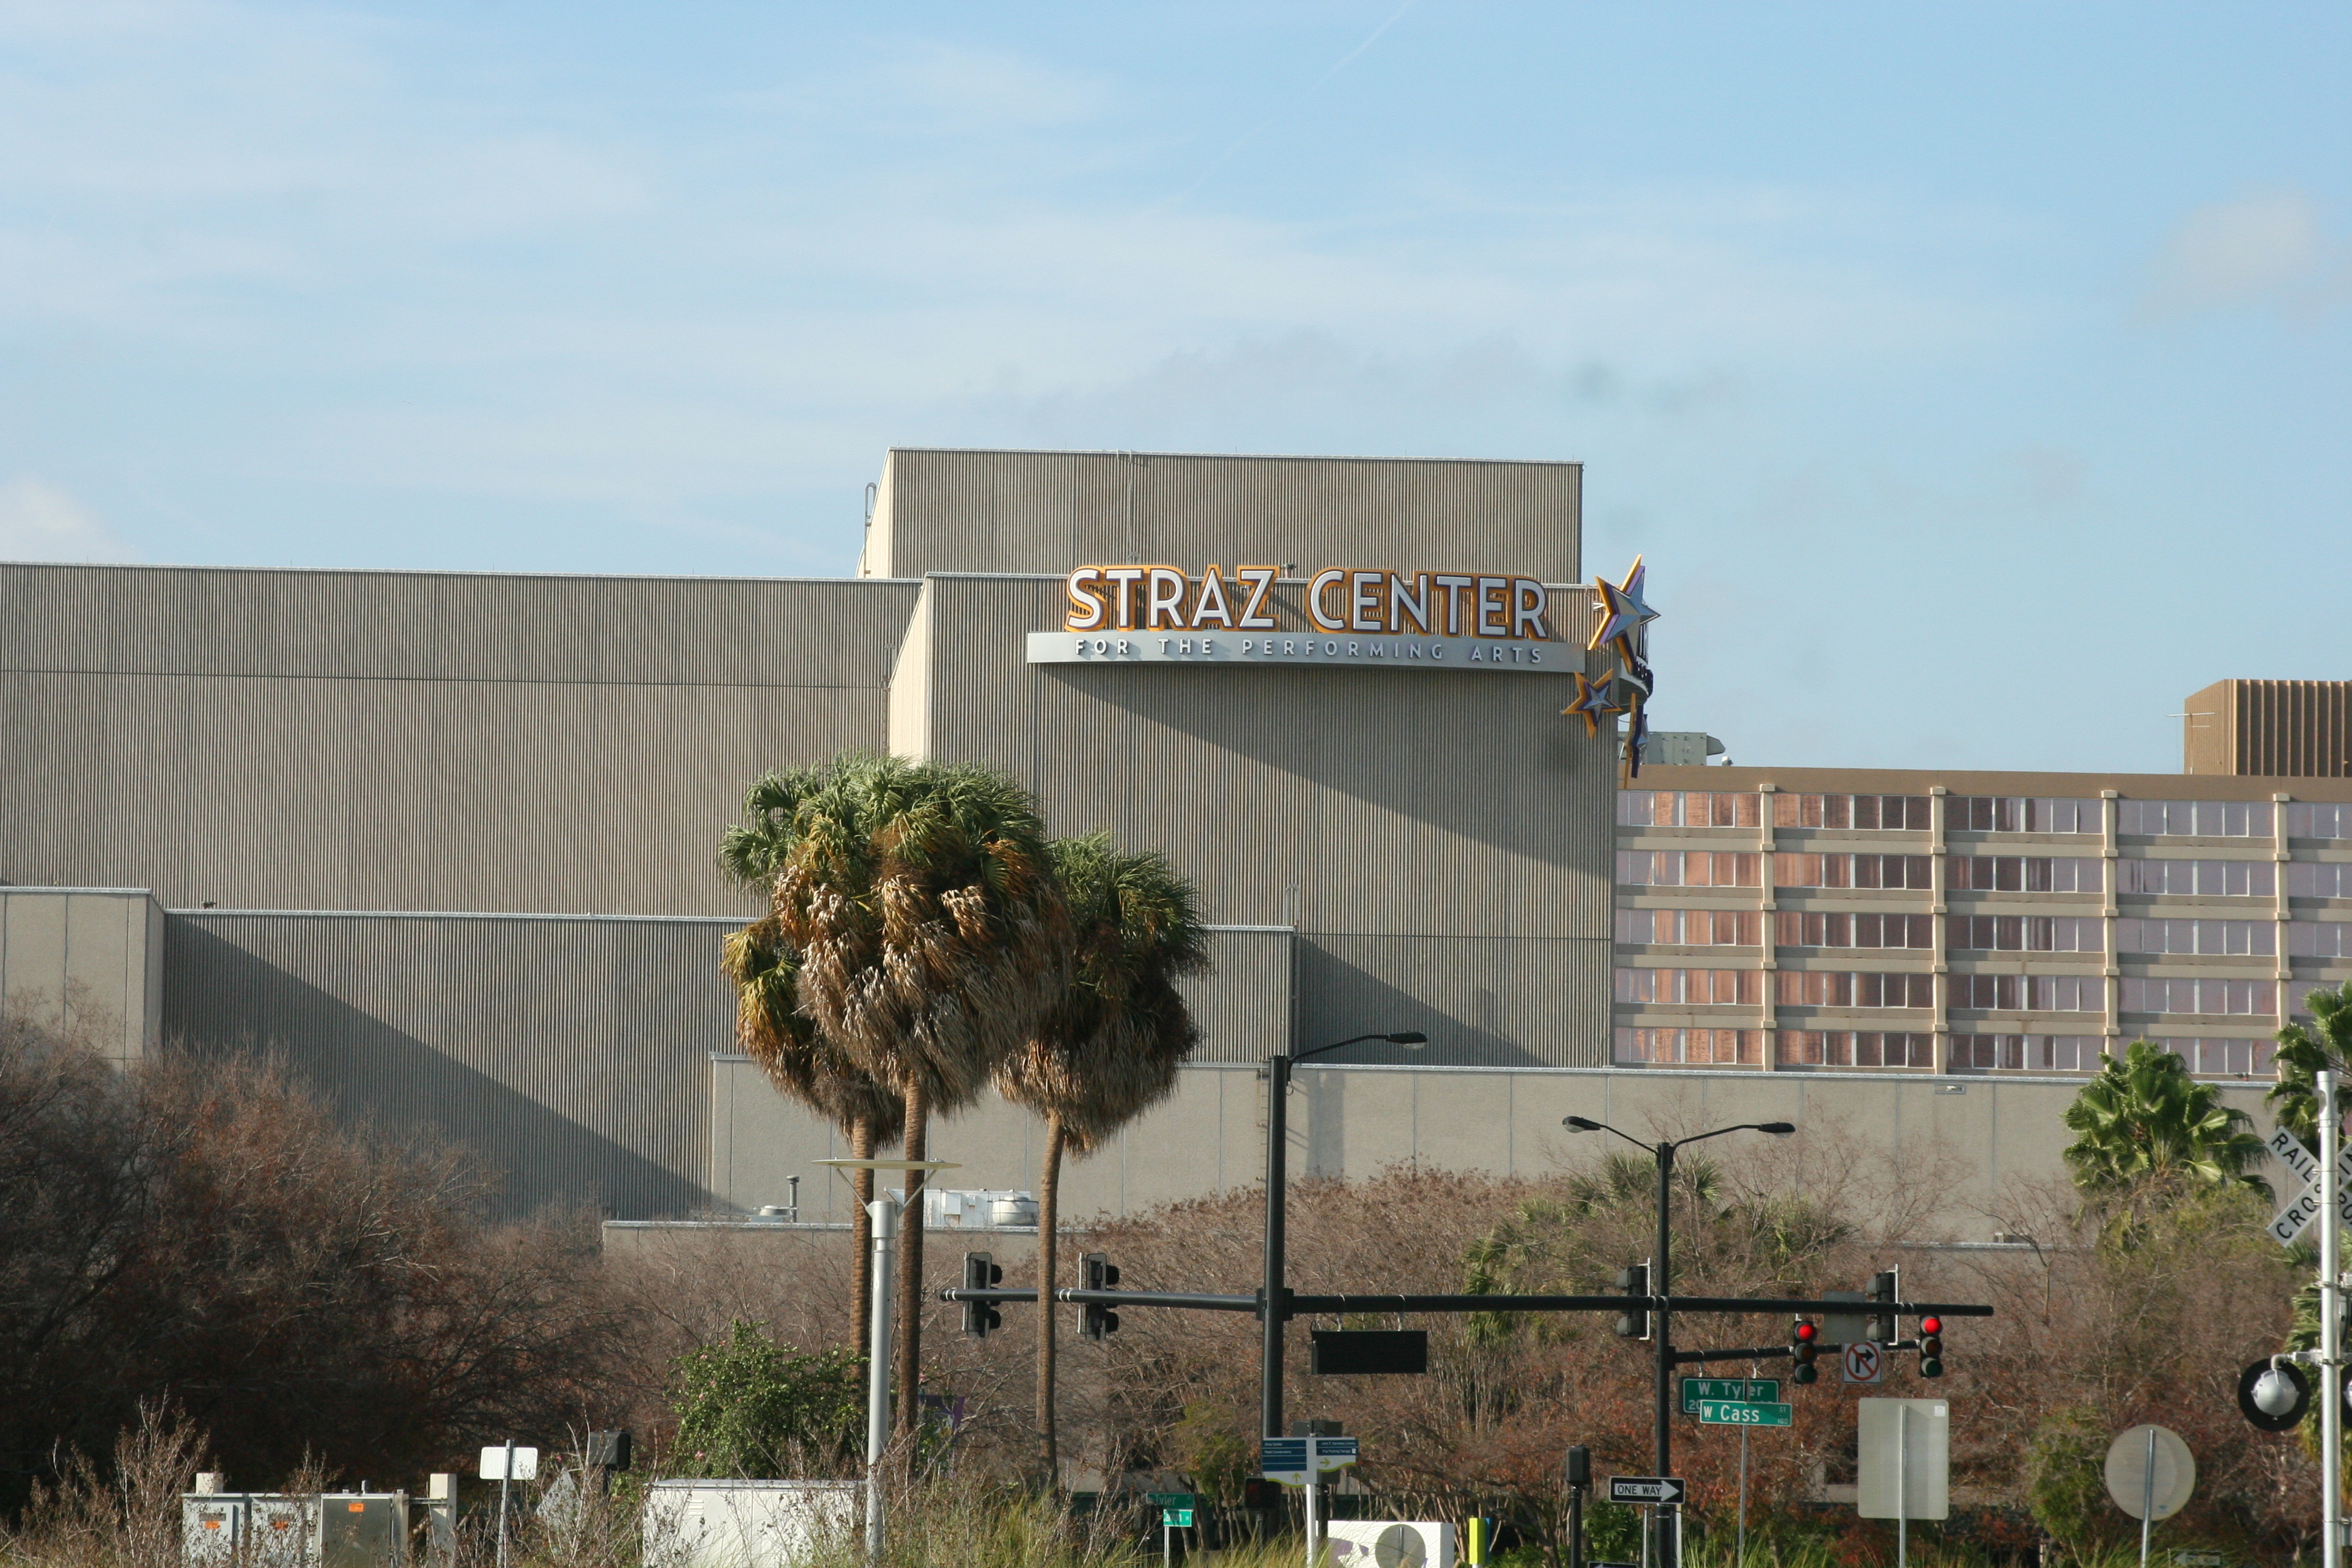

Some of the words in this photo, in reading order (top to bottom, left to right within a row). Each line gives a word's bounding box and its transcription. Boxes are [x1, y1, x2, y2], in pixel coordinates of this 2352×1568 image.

[1066, 568, 1275, 630] STRAZ
[1309, 569, 1549, 640] CENTER
[1075, 638, 1128, 655] FOR
[1158, 638, 1212, 655] THE
[1242, 638, 1443, 660] PERFORMING
[1471, 645, 1542, 664] ARTS
[2271, 1132, 2315, 1183] RAIL
[1697, 1382, 1714, 1396] W.
[1722, 1382, 1765, 1399] Tyer
[1703, 1405, 1713, 1418] W
[1720, 1404, 1760, 1422] Cass
[1617, 1484, 1637, 1494] ONE
[1642, 1485, 1662, 1496] WAY
